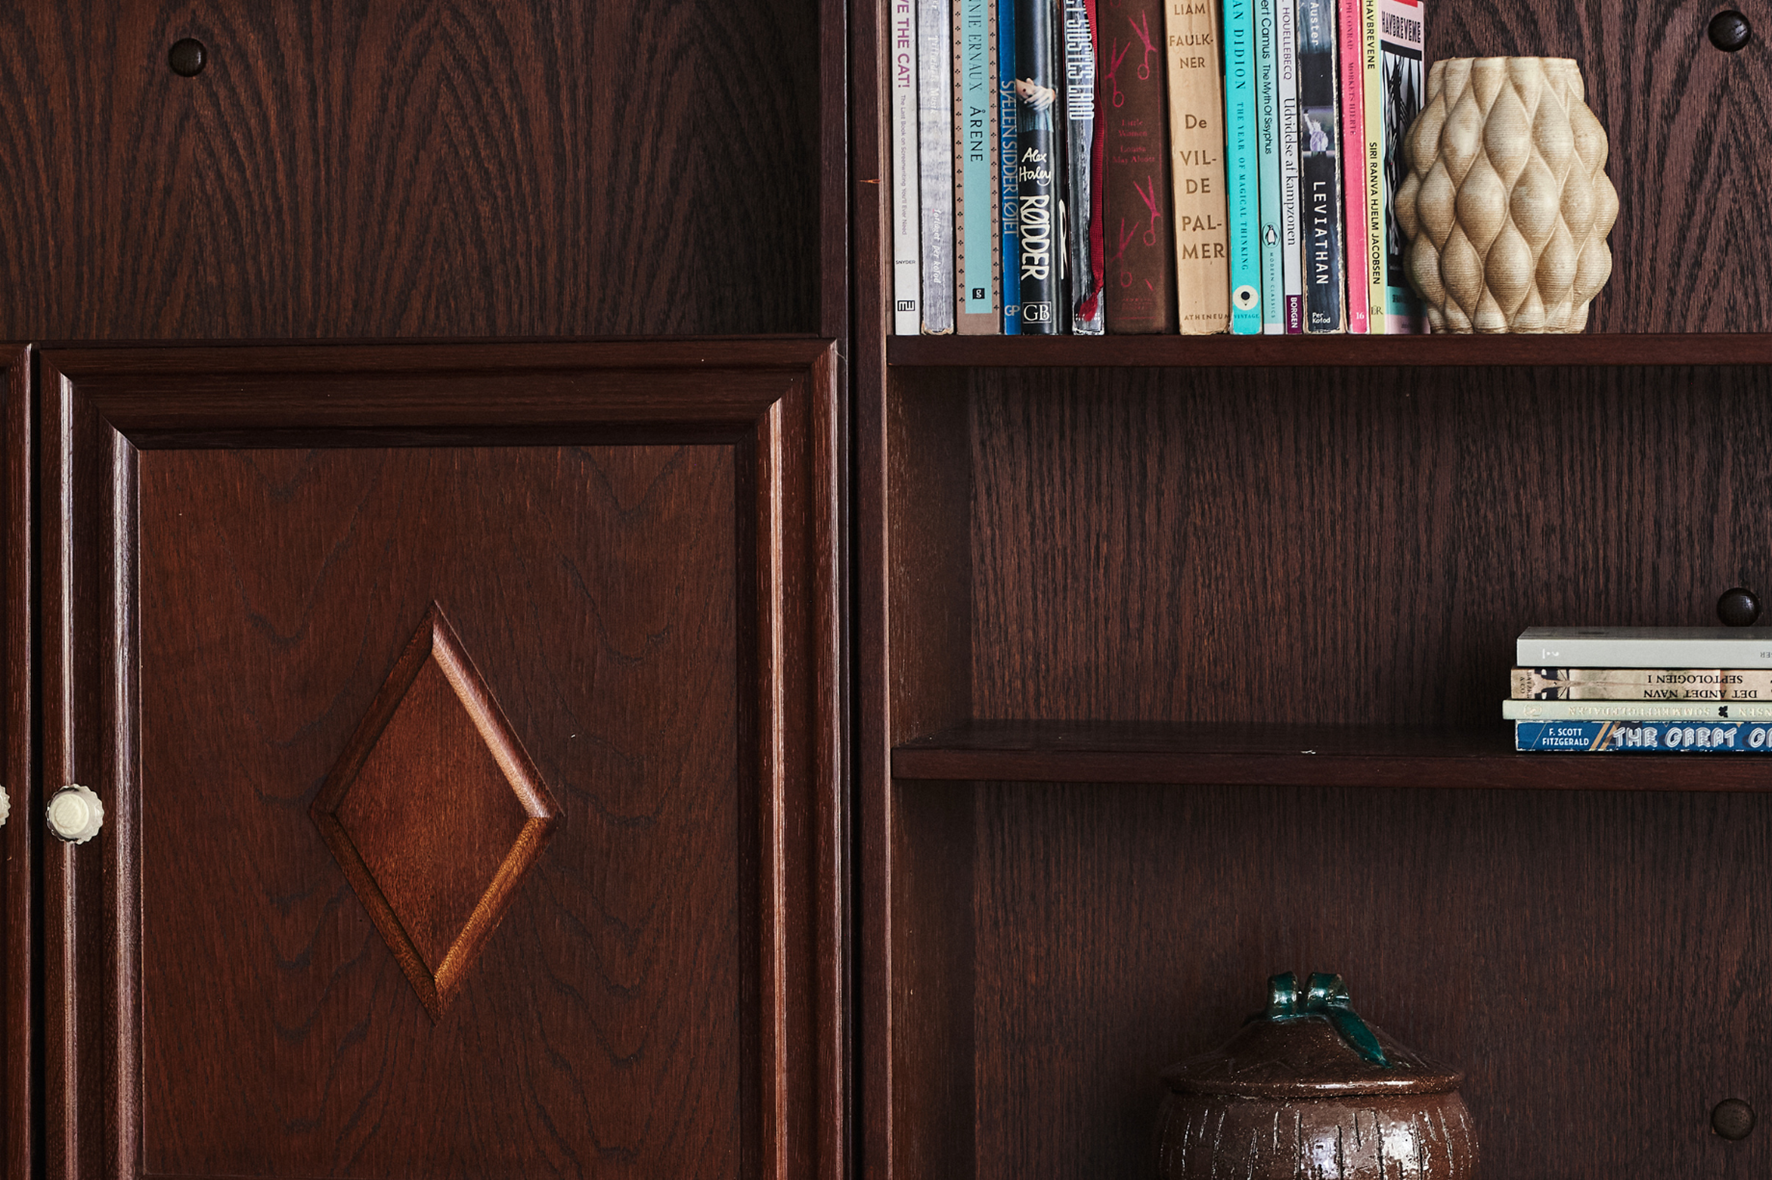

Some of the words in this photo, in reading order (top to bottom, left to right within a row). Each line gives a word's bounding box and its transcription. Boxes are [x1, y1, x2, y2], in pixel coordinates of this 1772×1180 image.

[1174, 3, 1206, 15] LIAM
[897, 18, 910, 49] THE
[1310, 1, 1319, 46] Auster
[1346, 15, 1354, 50] CONRAD
[1366, 0, 1375, 70] HAVBREVENE
[1381, 11, 1421, 43] HAVBREVENE
[1169, 33, 1213, 47] FAULK-
[1261, 17, 1272, 60] Camus
[1282, 7, 1292, 80] HOUELLEBECQ
[897, 53, 910, 88] CAT!
[968, 34, 983, 91] ERNAUX
[1180, 57, 1205, 69] NER
[1233, 29, 1246, 89] DIDION
[1262, 64, 1271, 81] The
[1068, 85, 1095, 120] LAND
[1262, 81, 1272, 105] Myth
[1000, 80, 1017, 137] SJÆLEN
[1264, 105, 1272, 116] Of
[969, 105, 986, 162] ÅRENE
[1185, 114, 1207, 129] De
[1284, 97, 1298, 157] Udvidelse
[901, 138, 906, 146] on
[1237, 125, 1245, 150] YEAR
[1263, 117, 1273, 155] Sisyphus
[1021, 147, 1047, 163] Alex
[1179, 150, 1217, 166] VIL-
[1369, 142, 1377, 159] SIRI
[1002, 141, 1018, 194] SIDDER
[1238, 157, 1246, 170] OF
[1285, 160, 1298, 172] af
[1018, 166, 1051, 187] Haley
[1186, 177, 1211, 194] DE
[1370, 162, 1378, 196] RANVA
[1239, 173, 1247, 218] MAGICAL
[1003, 202, 1019, 237] ØJET
[1284, 175, 1298, 246] kampzonen
[1371, 199, 1379, 231] HJELM
[1182, 214, 1222, 232] PAL-
[1313, 181, 1329, 285] LEVIATHAN
[1019, 194, 1050, 281] RØDDER
[1240, 221, 1249, 270] THINKING
[932, 244, 942, 258] per
[1182, 242, 1225, 260] MER
[1372, 233, 1380, 285] JACOBSEN
[933, 260, 942, 284] kofod
[1004, 305, 1020, 316] GP
[1290, 297, 1298, 329] BORGEN
[1648, 675, 1652, 684] I
[1656, 674, 1743, 684] SEPTOLOGIEN
[1643, 689, 1678, 699] NAVN
[1683, 689, 1727, 699] ANDET
[1731, 689, 1757, 699] DET
[1567, 706, 1710, 717] SOMMERFUGLEDALEN
[1542, 737, 1589, 746] FITZGERALD
[1549, 728, 1555, 736] F.
[1557, 728, 1582, 736] SCOTT
[1612, 727, 1658, 747] THE
[1664, 727, 1737, 748] GREAT
